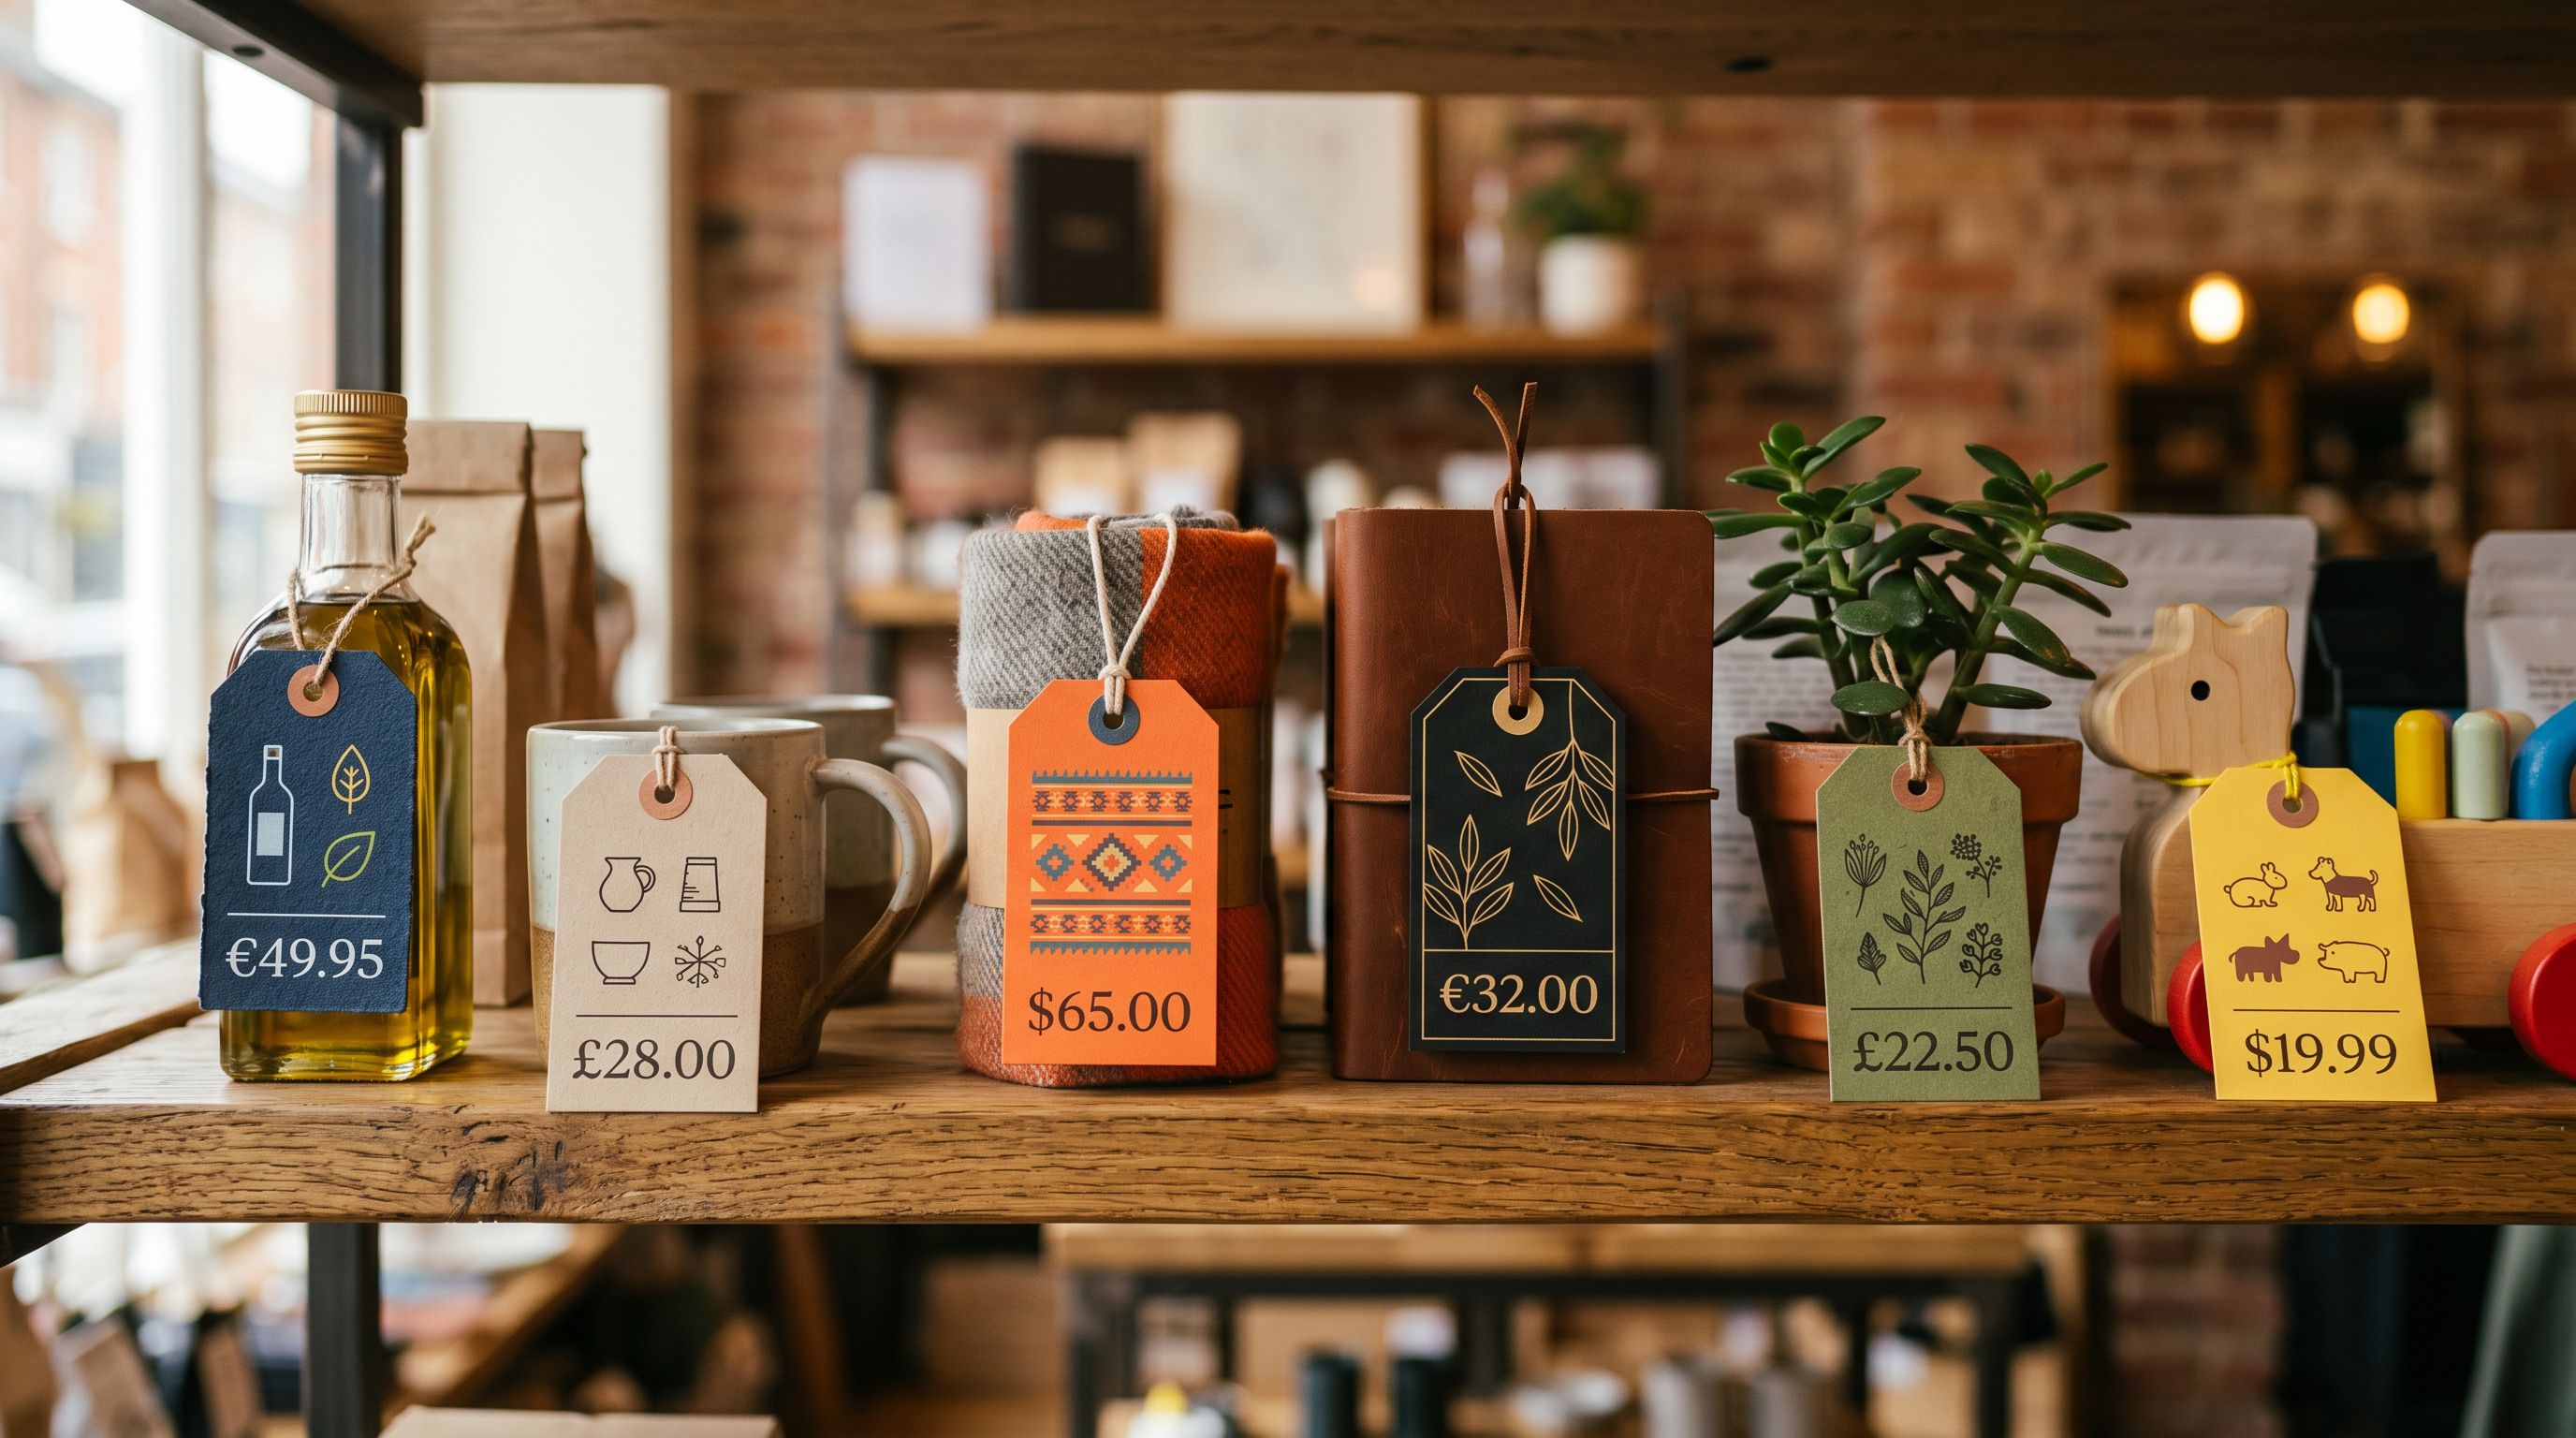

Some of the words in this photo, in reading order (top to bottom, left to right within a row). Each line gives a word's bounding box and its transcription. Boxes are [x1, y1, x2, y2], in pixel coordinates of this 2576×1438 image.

[226, 937, 384, 979] €49.95
[1029, 987, 1192, 1035] $65.00
[1440, 974, 1598, 1014] €32.00
[572, 1039, 735, 1079] £28.00
[1852, 1031, 2014, 1072] £22.50
[2245, 1029, 2397, 1078] $19.99
